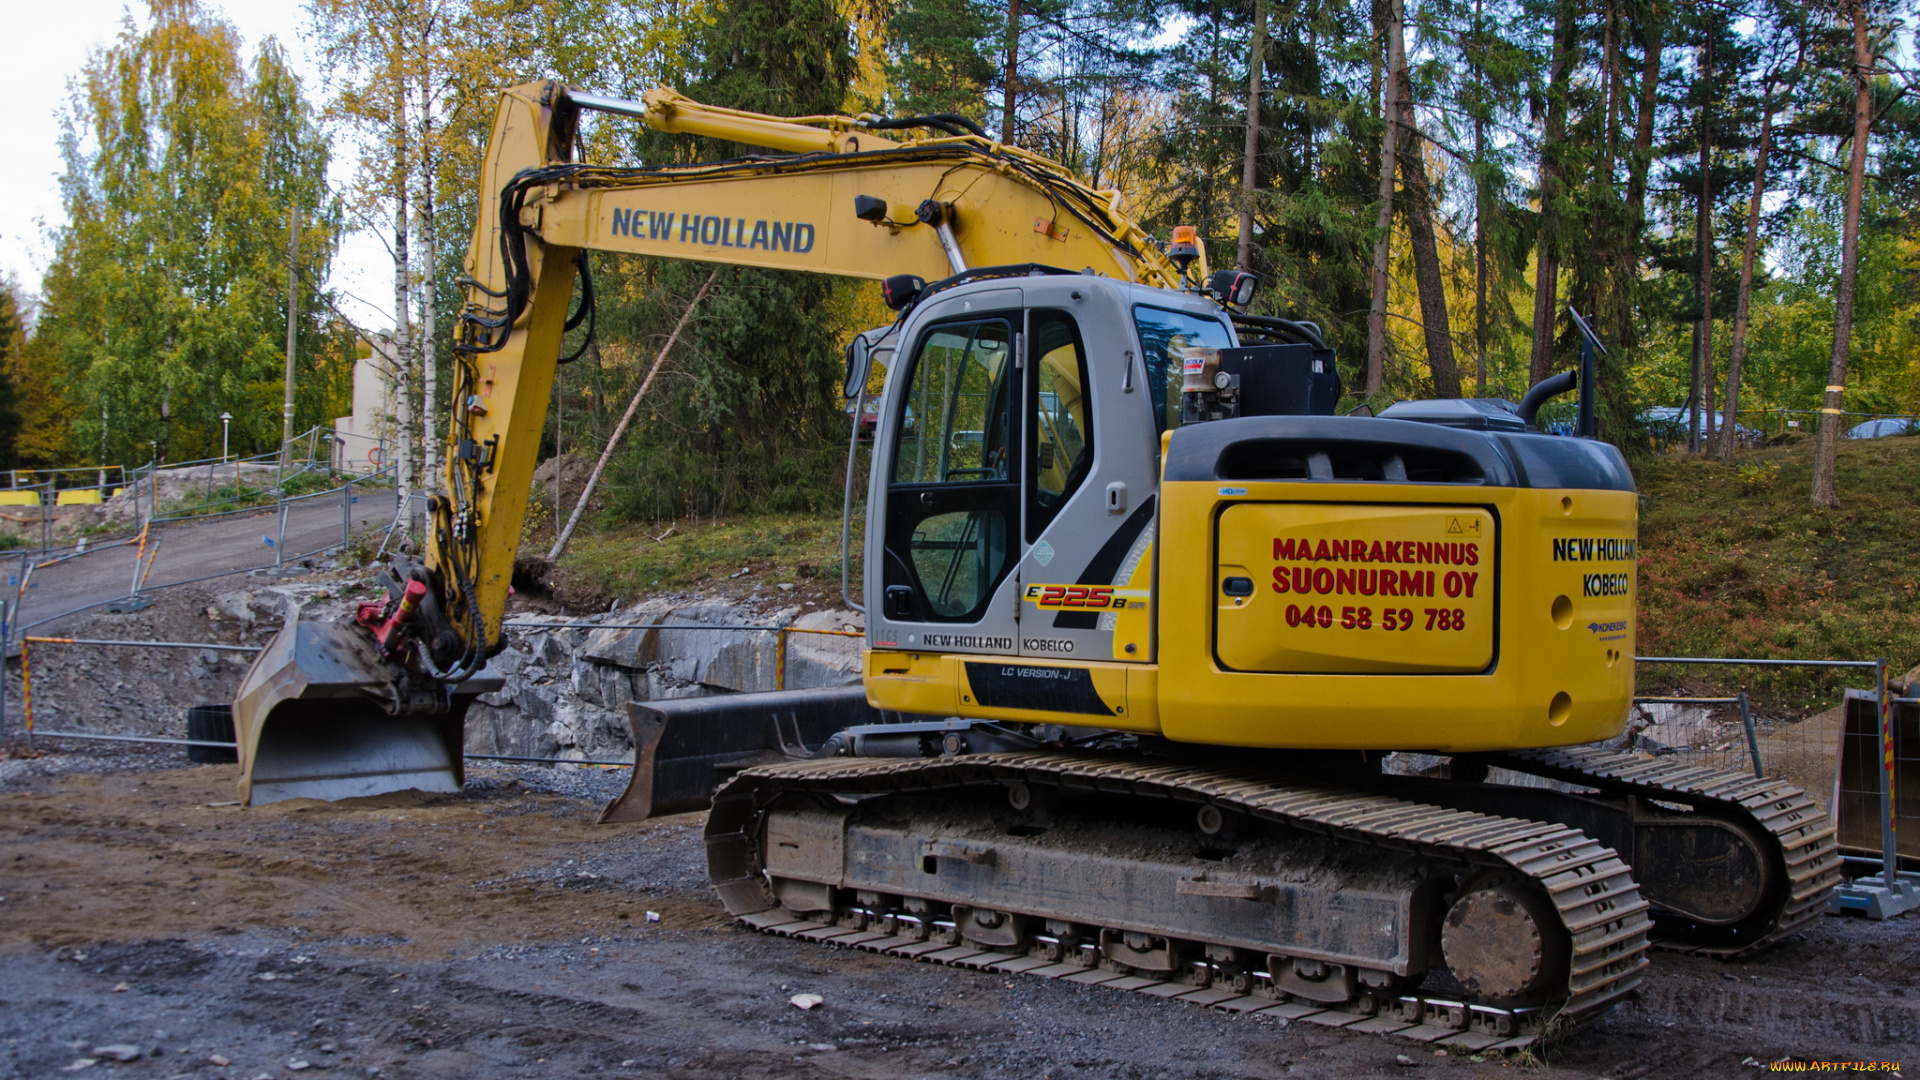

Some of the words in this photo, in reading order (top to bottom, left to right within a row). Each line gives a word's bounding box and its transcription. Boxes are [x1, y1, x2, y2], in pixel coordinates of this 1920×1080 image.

[612, 207, 675, 241] NEW
[680, 213, 815, 254] HOLLAND
[1272, 537, 1479, 566] MAANRAKENNUS
[1553, 538, 1593, 561] NEW
[1272, 566, 1435, 597] SUONURMI
[1443, 571, 1479, 598] OY
[1583, 573, 1628, 597] KOBELCO
[1285, 604, 1332, 629] 040
[1341, 606, 1372, 630] 58
[1382, 608, 1413, 631] 59
[1424, 608, 1465, 631] 788
[923, 634, 952, 647] NEW
[954, 635, 1012, 650] HOLLAND
[1023, 638, 1074, 653] KOBELCO
[1001, 667, 1014, 676] LC
